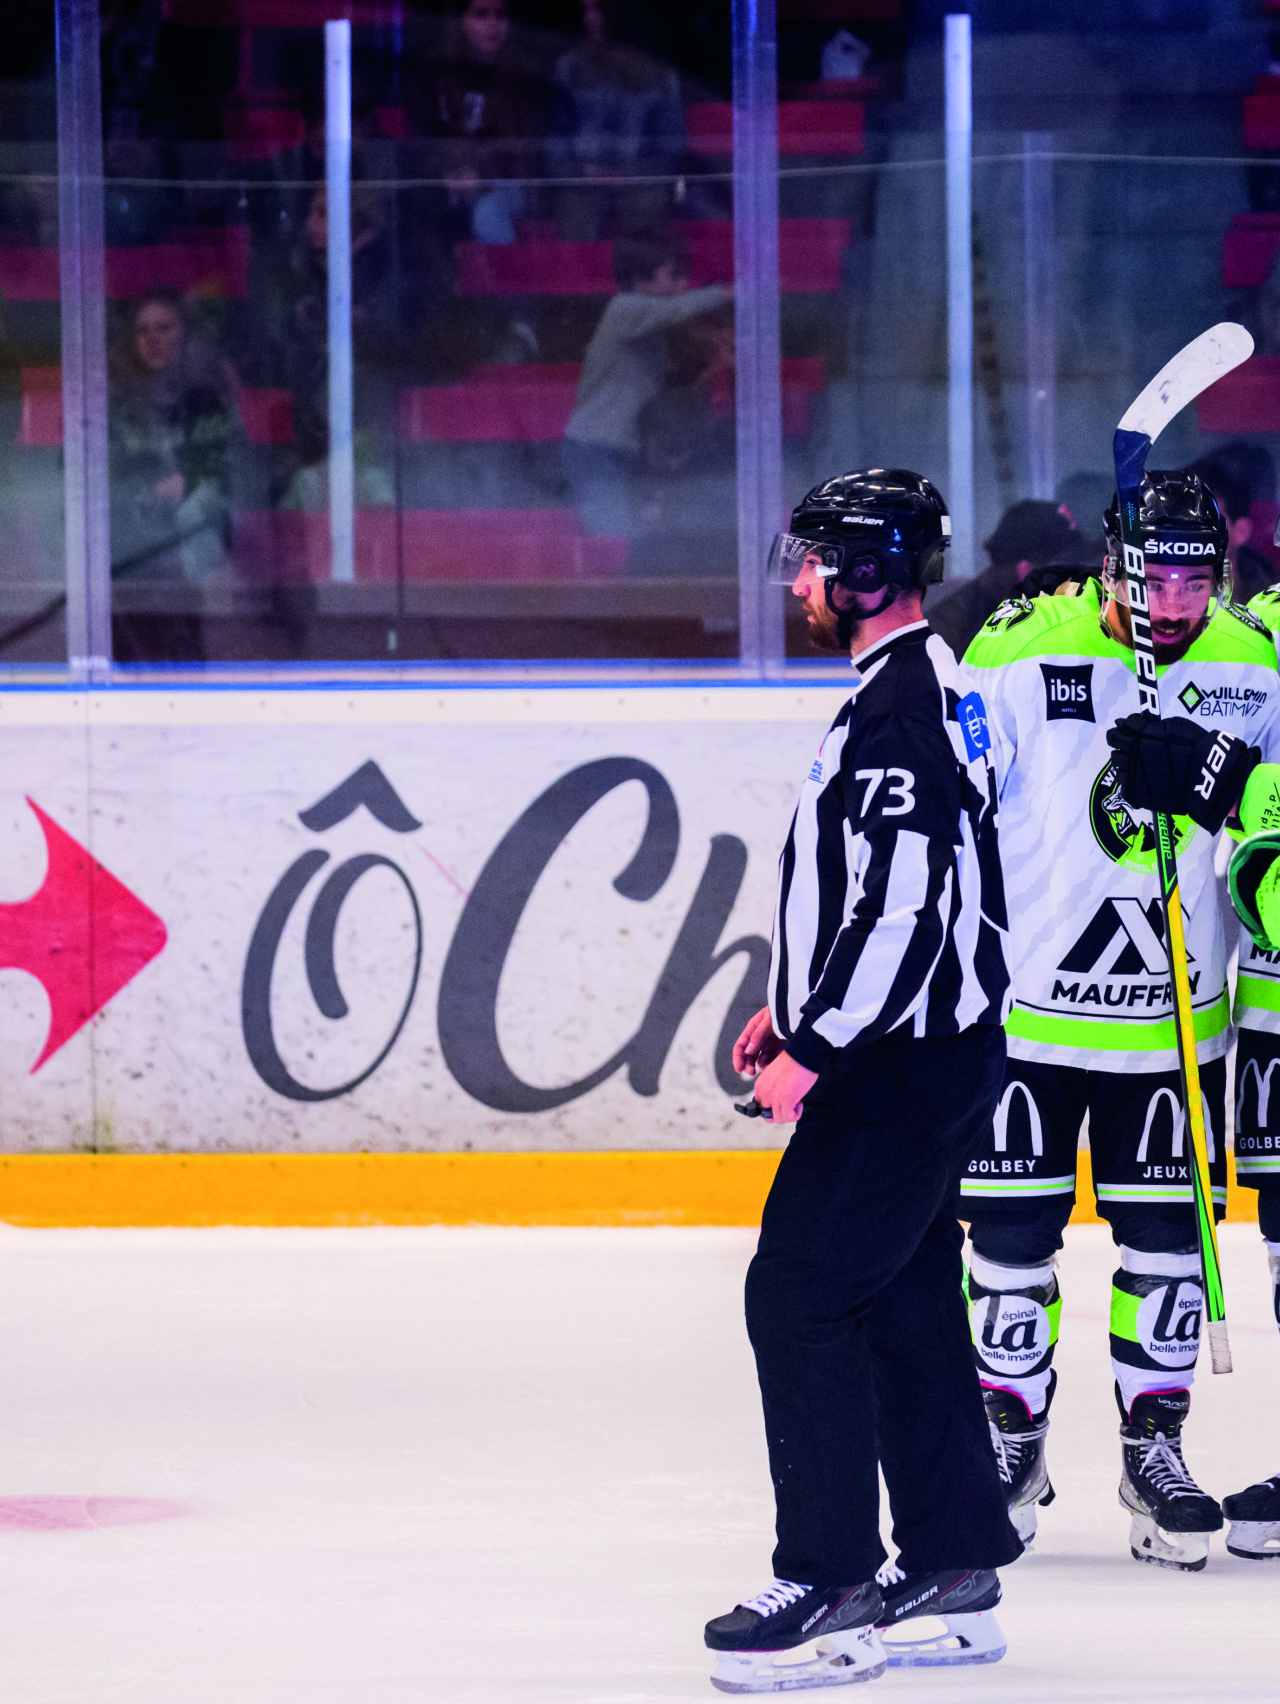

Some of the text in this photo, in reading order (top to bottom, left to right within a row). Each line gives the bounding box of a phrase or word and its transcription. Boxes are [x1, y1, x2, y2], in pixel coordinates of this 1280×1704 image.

[842, 515, 884, 526] BAUER
[1144, 538, 1216, 556] ŠKODA
[1050, 678, 1087, 702] ibis
[1194, 730, 1236, 800] UER
[855, 767, 916, 818] 73
[241, 757, 774, 1113] ÔCh
[1051, 971, 1202, 1007] MAUFFRY
[967, 1159, 1037, 1173] GOLBEY
[981, 1295, 1038, 1352] la
[1002, 1306, 1037, 1322] épinal
[1152, 1284, 1202, 1342] la
[980, 1347, 1042, 1362] belle image
[1149, 1342, 1177, 1354] belle
[895, 1585, 939, 1616] BAUER
[801, 1604, 829, 1634] BAUER
